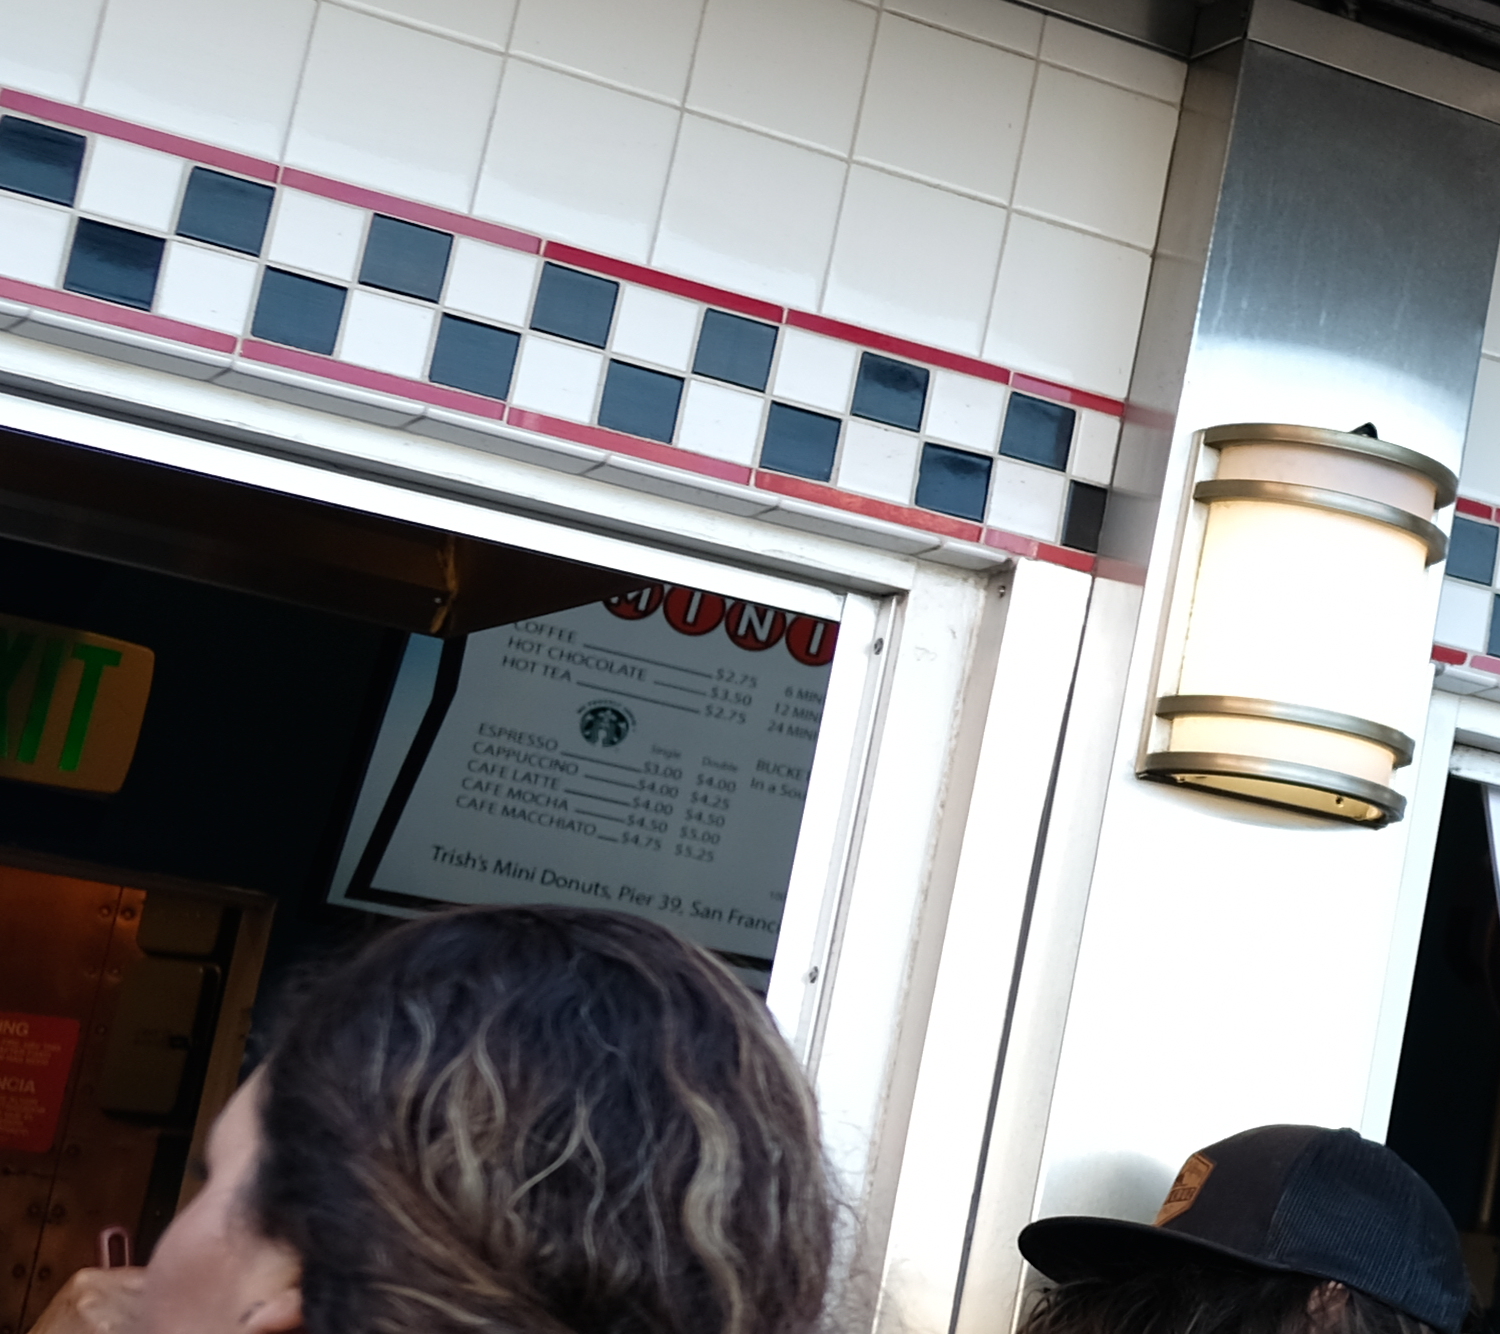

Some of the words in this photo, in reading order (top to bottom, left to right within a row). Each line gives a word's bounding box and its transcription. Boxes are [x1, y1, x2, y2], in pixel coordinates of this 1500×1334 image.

[508, 635, 543, 656] HOT
[548, 646, 648, 682] CHOCOLATE
[710, 685, 752, 707] $3.50
[514, 620, 578, 644] COFFEE
[715, 668, 758, 689] $2.75
[502, 655, 538, 675] HOT
[542, 664, 573, 683] TEA
[704, 703, 747, 725] $2.75
[774, 702, 790, 717] 12
[784, 686, 794, 698] 6
[478, 722, 559, 752] ESPRESSO
[643, 760, 684, 781] $3.00
[695, 772, 737, 794] $4.00
[767, 719, 784, 734] 24
[461, 777, 503, 797] CAFE
[506, 787, 569, 812] MOCHA
[626, 813, 669, 834] $4.50
[466, 759, 508, 779] CAFE
[512, 769, 561, 791] LATTE
[632, 796, 675, 816] $4.00
[684, 808, 726, 829] $4.50
[472, 740, 579, 776] CAPPUCCINO
[638, 778, 680, 799] $4.00
[690, 790, 730, 811] $4.25
[455, 795, 497, 815] CAFE
[501, 804, 598, 837] MACCHIATO
[621, 830, 662, 852] $4.75
[431, 843, 488, 873] Trish's
[492, 858, 538, 883] Mini
[540, 867, 612, 900] Donuts,
[618, 885, 656, 908] Pier
[658, 893, 683, 916] 39,
[689, 899, 723, 923] San
